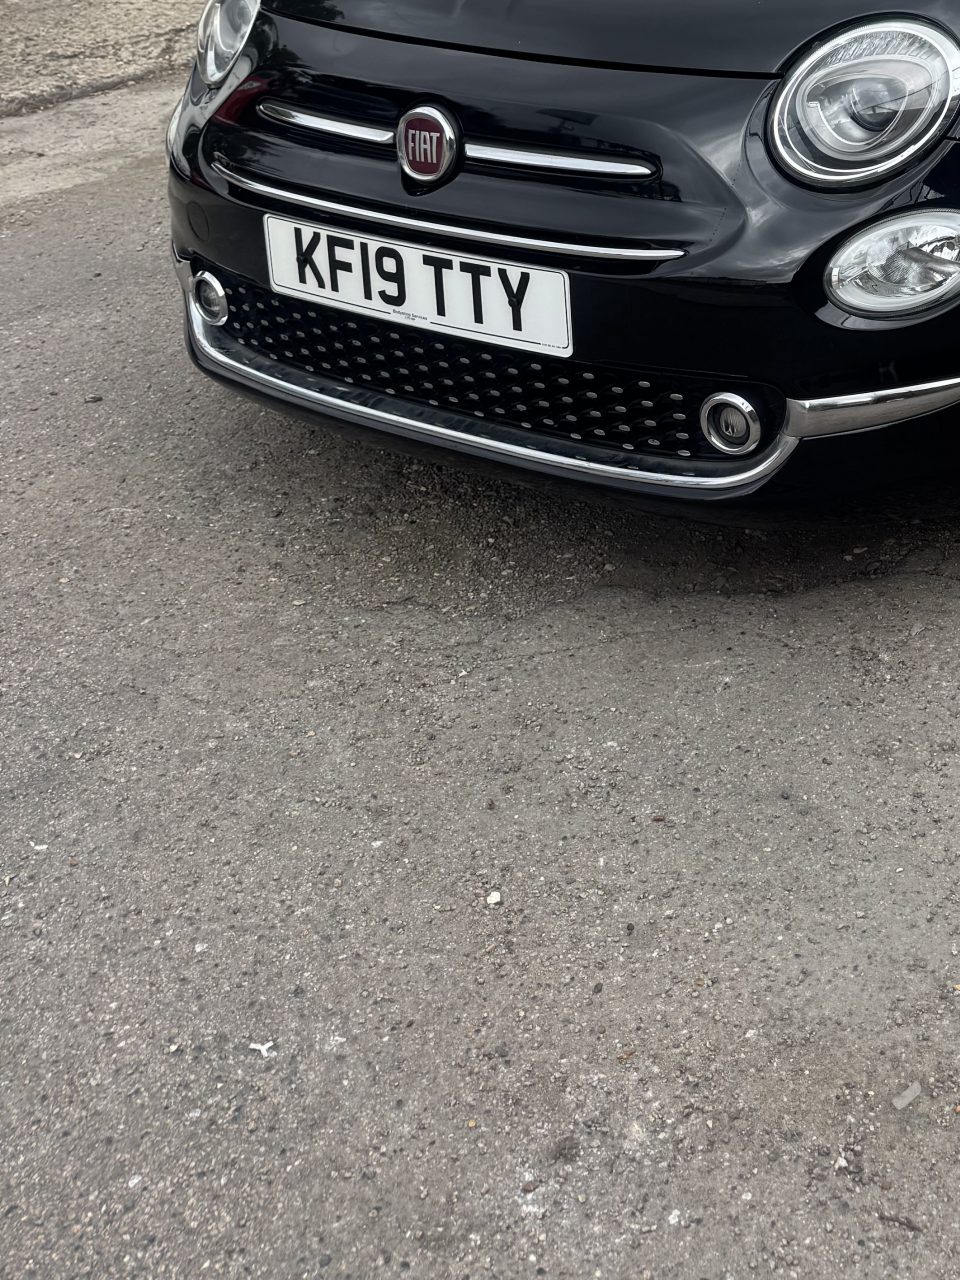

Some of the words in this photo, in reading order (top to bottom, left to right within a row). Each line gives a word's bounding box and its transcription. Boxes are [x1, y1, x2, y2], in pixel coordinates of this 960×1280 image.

[408, 129, 441, 163] FIAT
[294, 226, 407, 308] KF19
[422, 254, 531, 332] TTY
